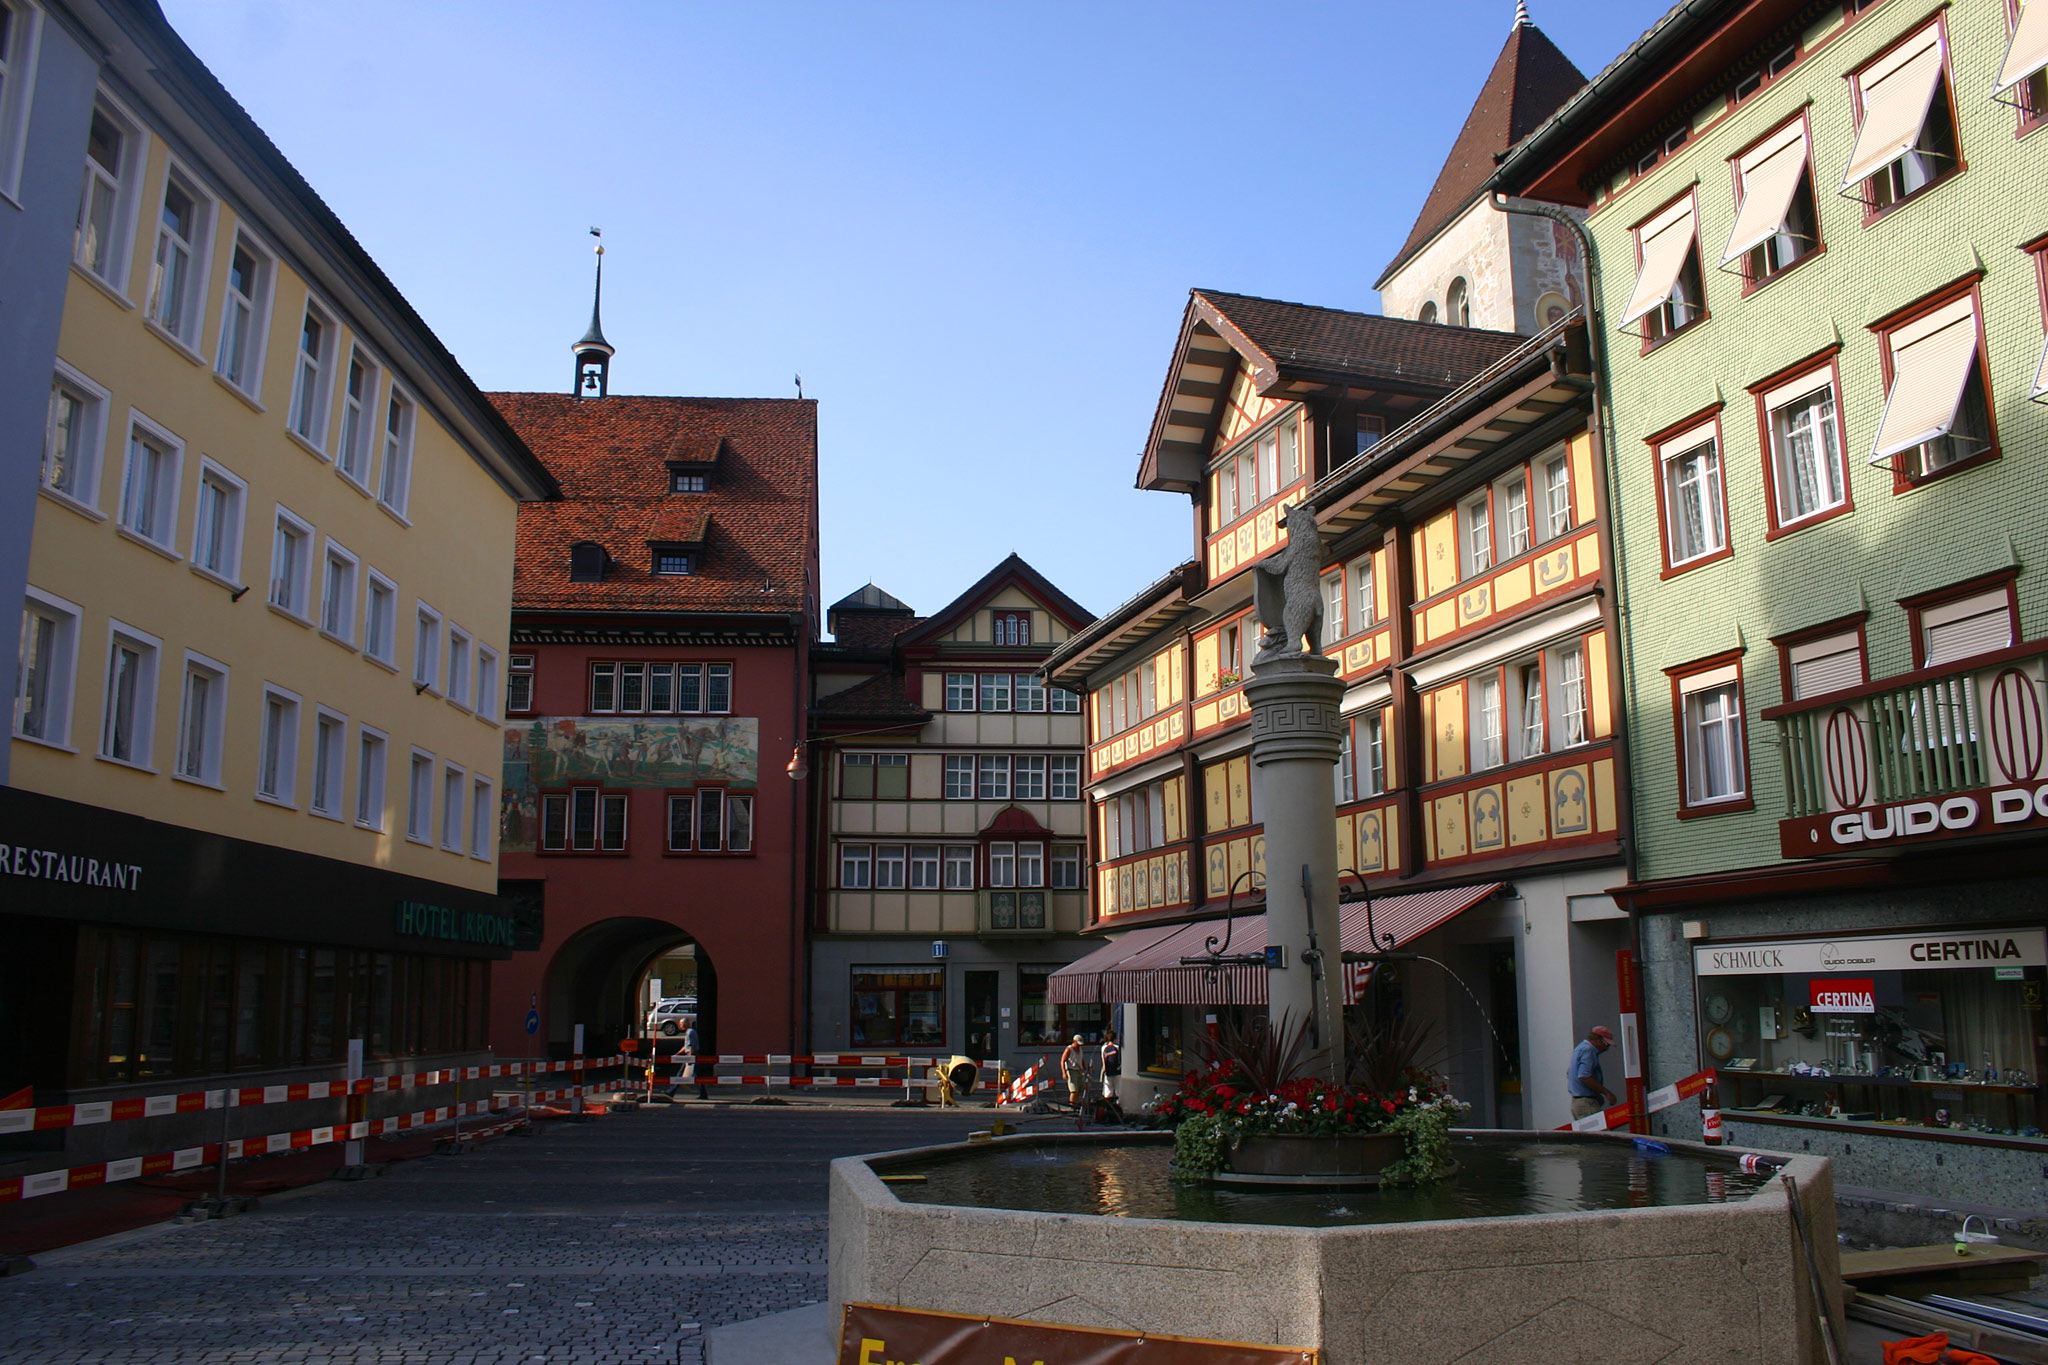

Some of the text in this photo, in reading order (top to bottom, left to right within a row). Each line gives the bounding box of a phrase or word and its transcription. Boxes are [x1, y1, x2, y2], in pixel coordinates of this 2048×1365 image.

[1830, 796, 1980, 845] GUIDO
[0, 843, 143, 891] RESTAURANT
[400, 900, 516, 946] HOTEL KRONE
[1713, 949, 1784, 969] SCHMUCK
[1911, 938, 2022, 962] CERTINA
[1816, 991, 1874, 1007] CERTINA
